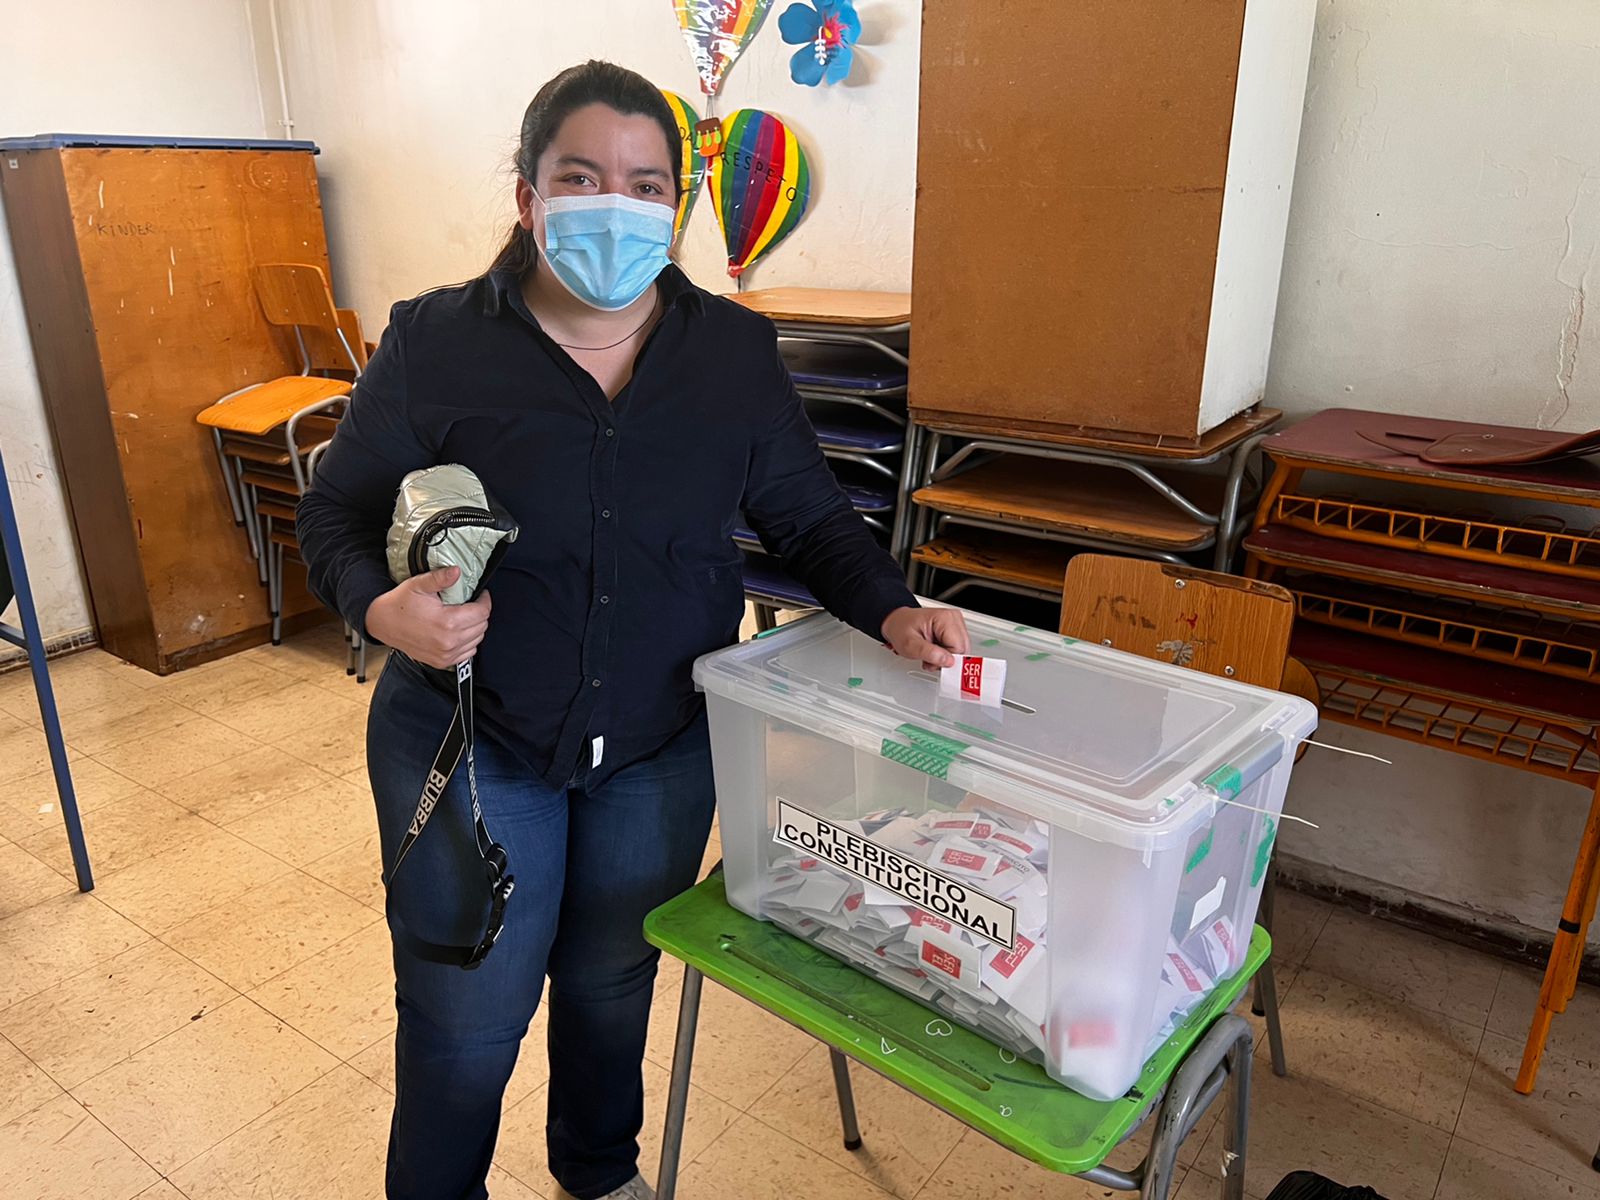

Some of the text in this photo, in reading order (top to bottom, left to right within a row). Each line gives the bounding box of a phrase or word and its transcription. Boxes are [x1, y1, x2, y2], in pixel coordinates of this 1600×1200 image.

[720, 151, 798, 202] RESPETO
[96, 221, 156, 238] KINDER
[964, 663, 980, 676] SER
[408, 768, 447, 835] BUBBA
[783, 823, 1008, 944] CONSTITUCIONAL
[816, 820, 967, 904] PLEBISCITO
[1013, 941, 1029, 959] ER
